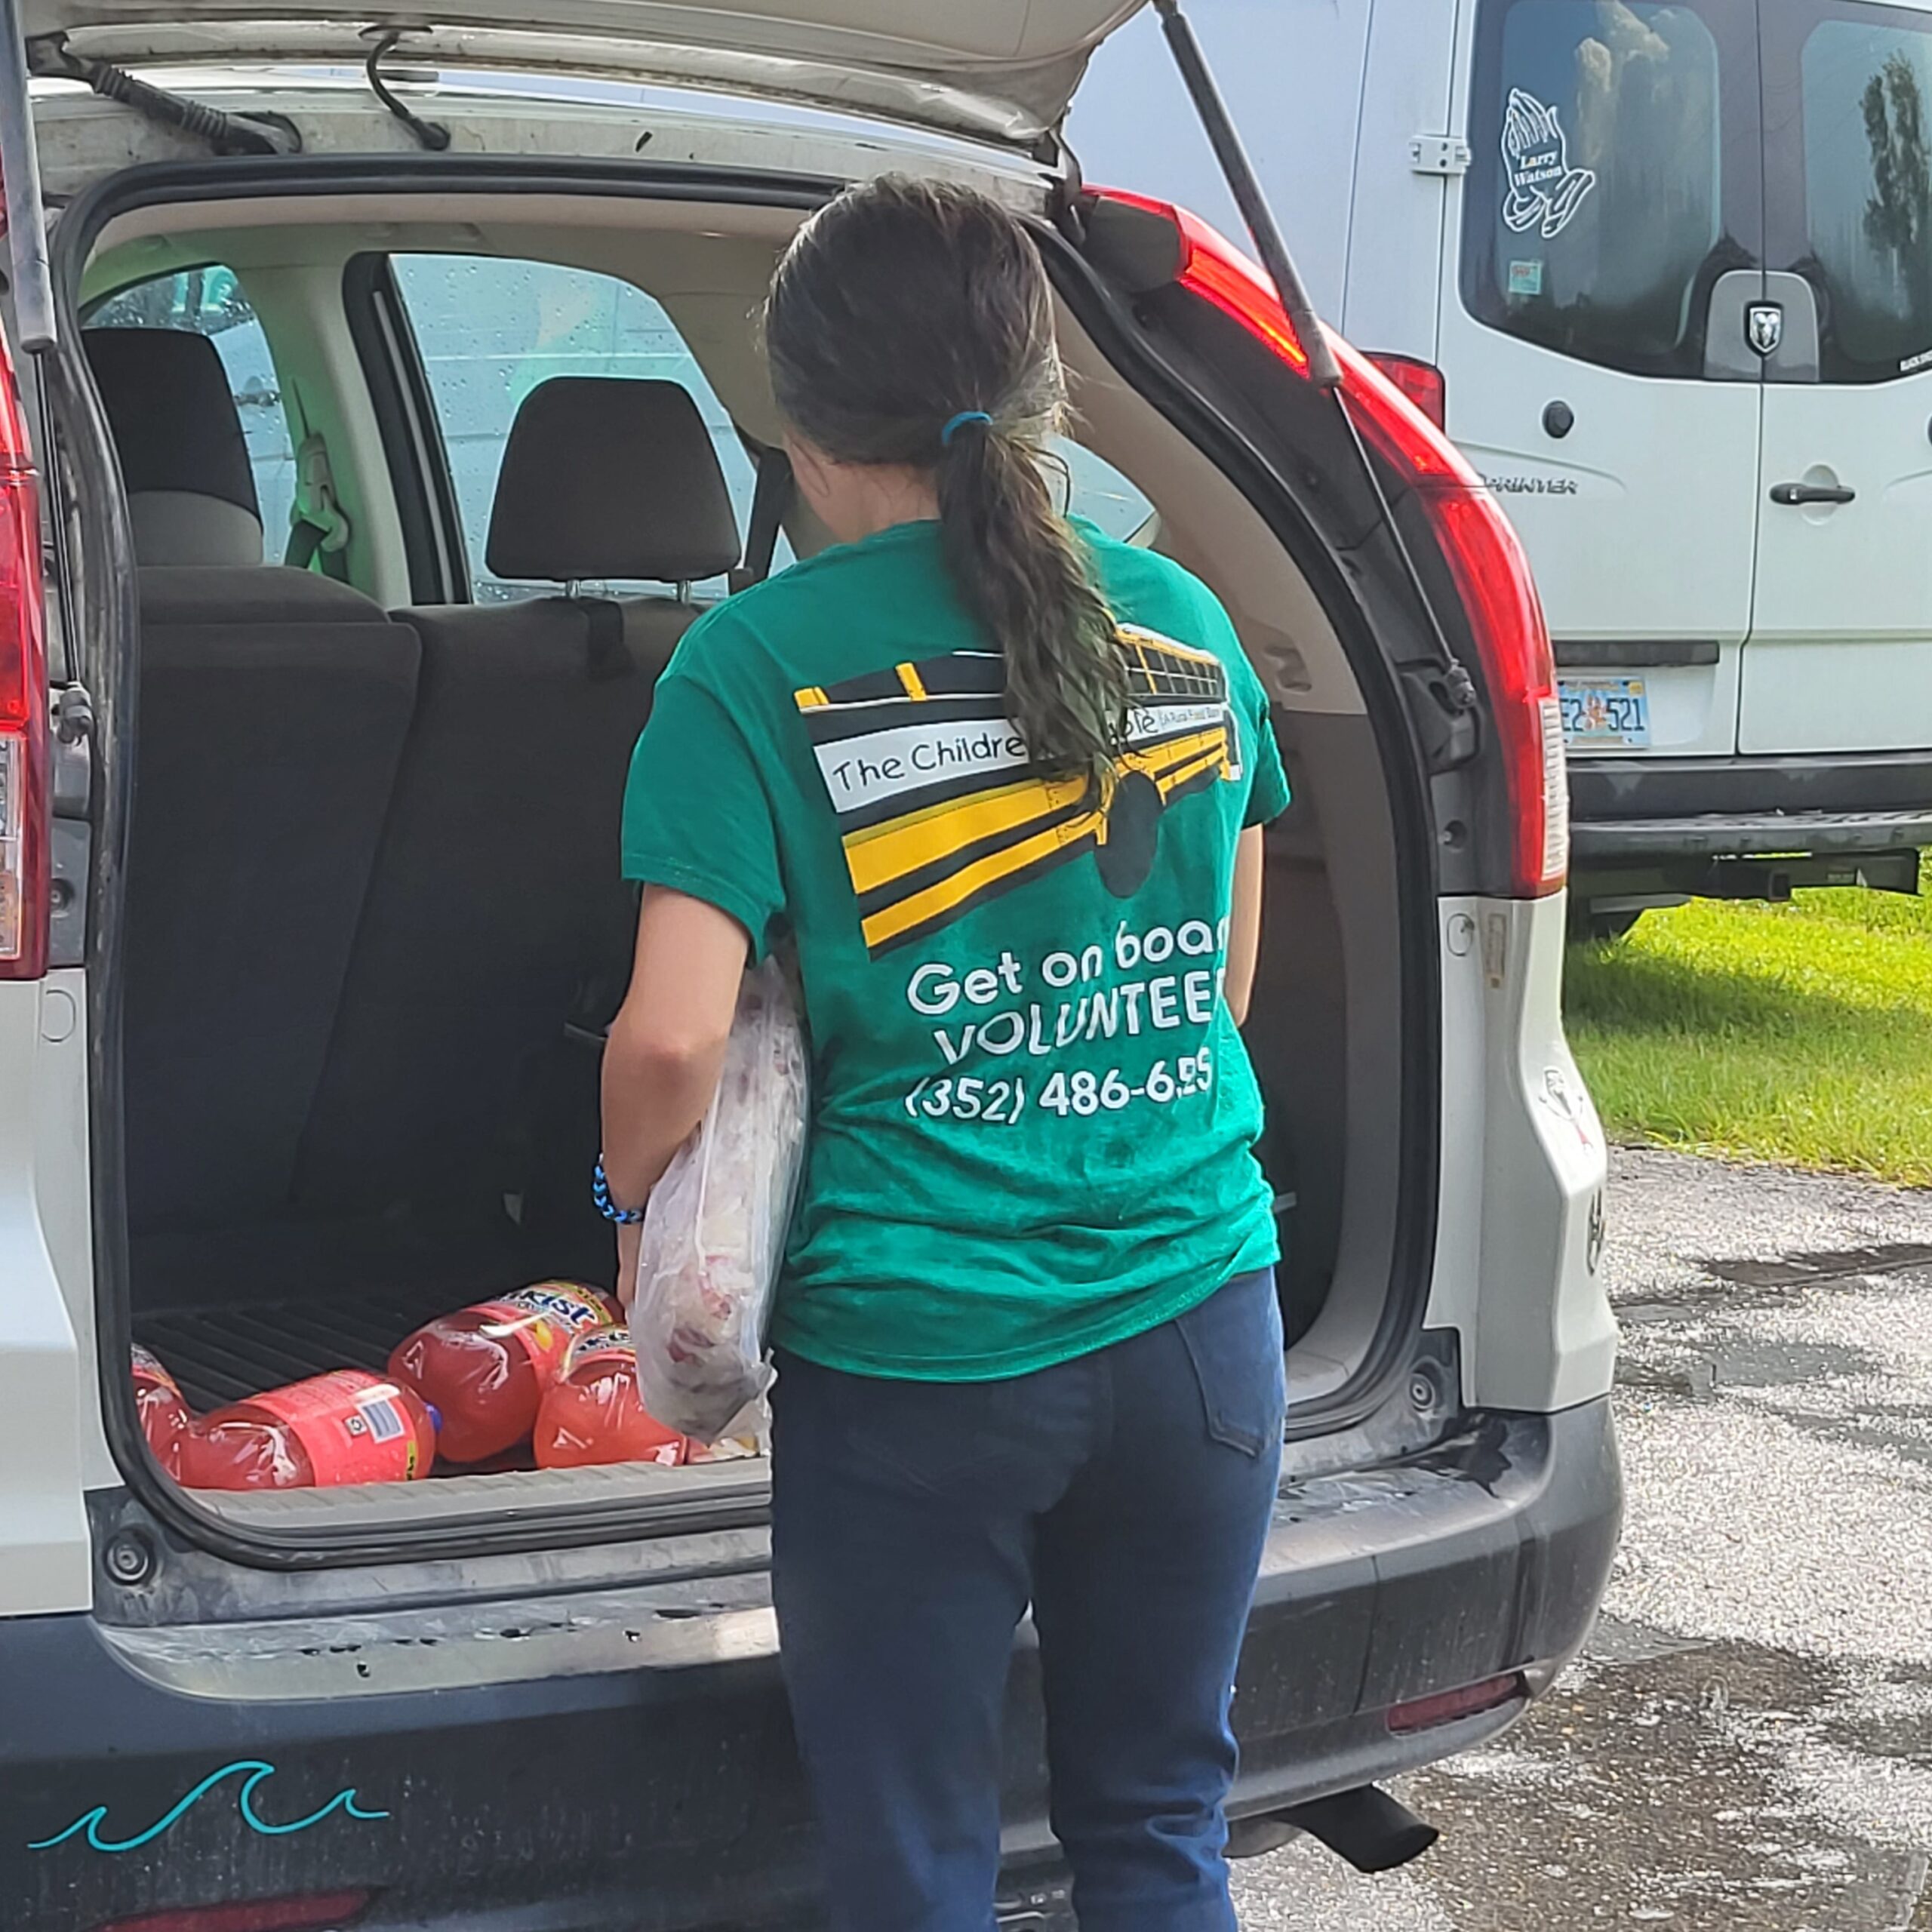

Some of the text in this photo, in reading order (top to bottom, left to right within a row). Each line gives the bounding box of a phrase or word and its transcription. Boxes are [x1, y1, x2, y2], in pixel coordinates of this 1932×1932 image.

[1514, 165, 1562, 187] Watson
[1519, 151, 1558, 170] Larry
[1485, 477, 1578, 495] PRINTER
[1605, 698, 1644, 731] 521
[832, 758, 905, 791] The
[907, 951, 1023, 1015] Get
[1042, 945, 1103, 987] on
[905, 1077, 1026, 1124] (352)
